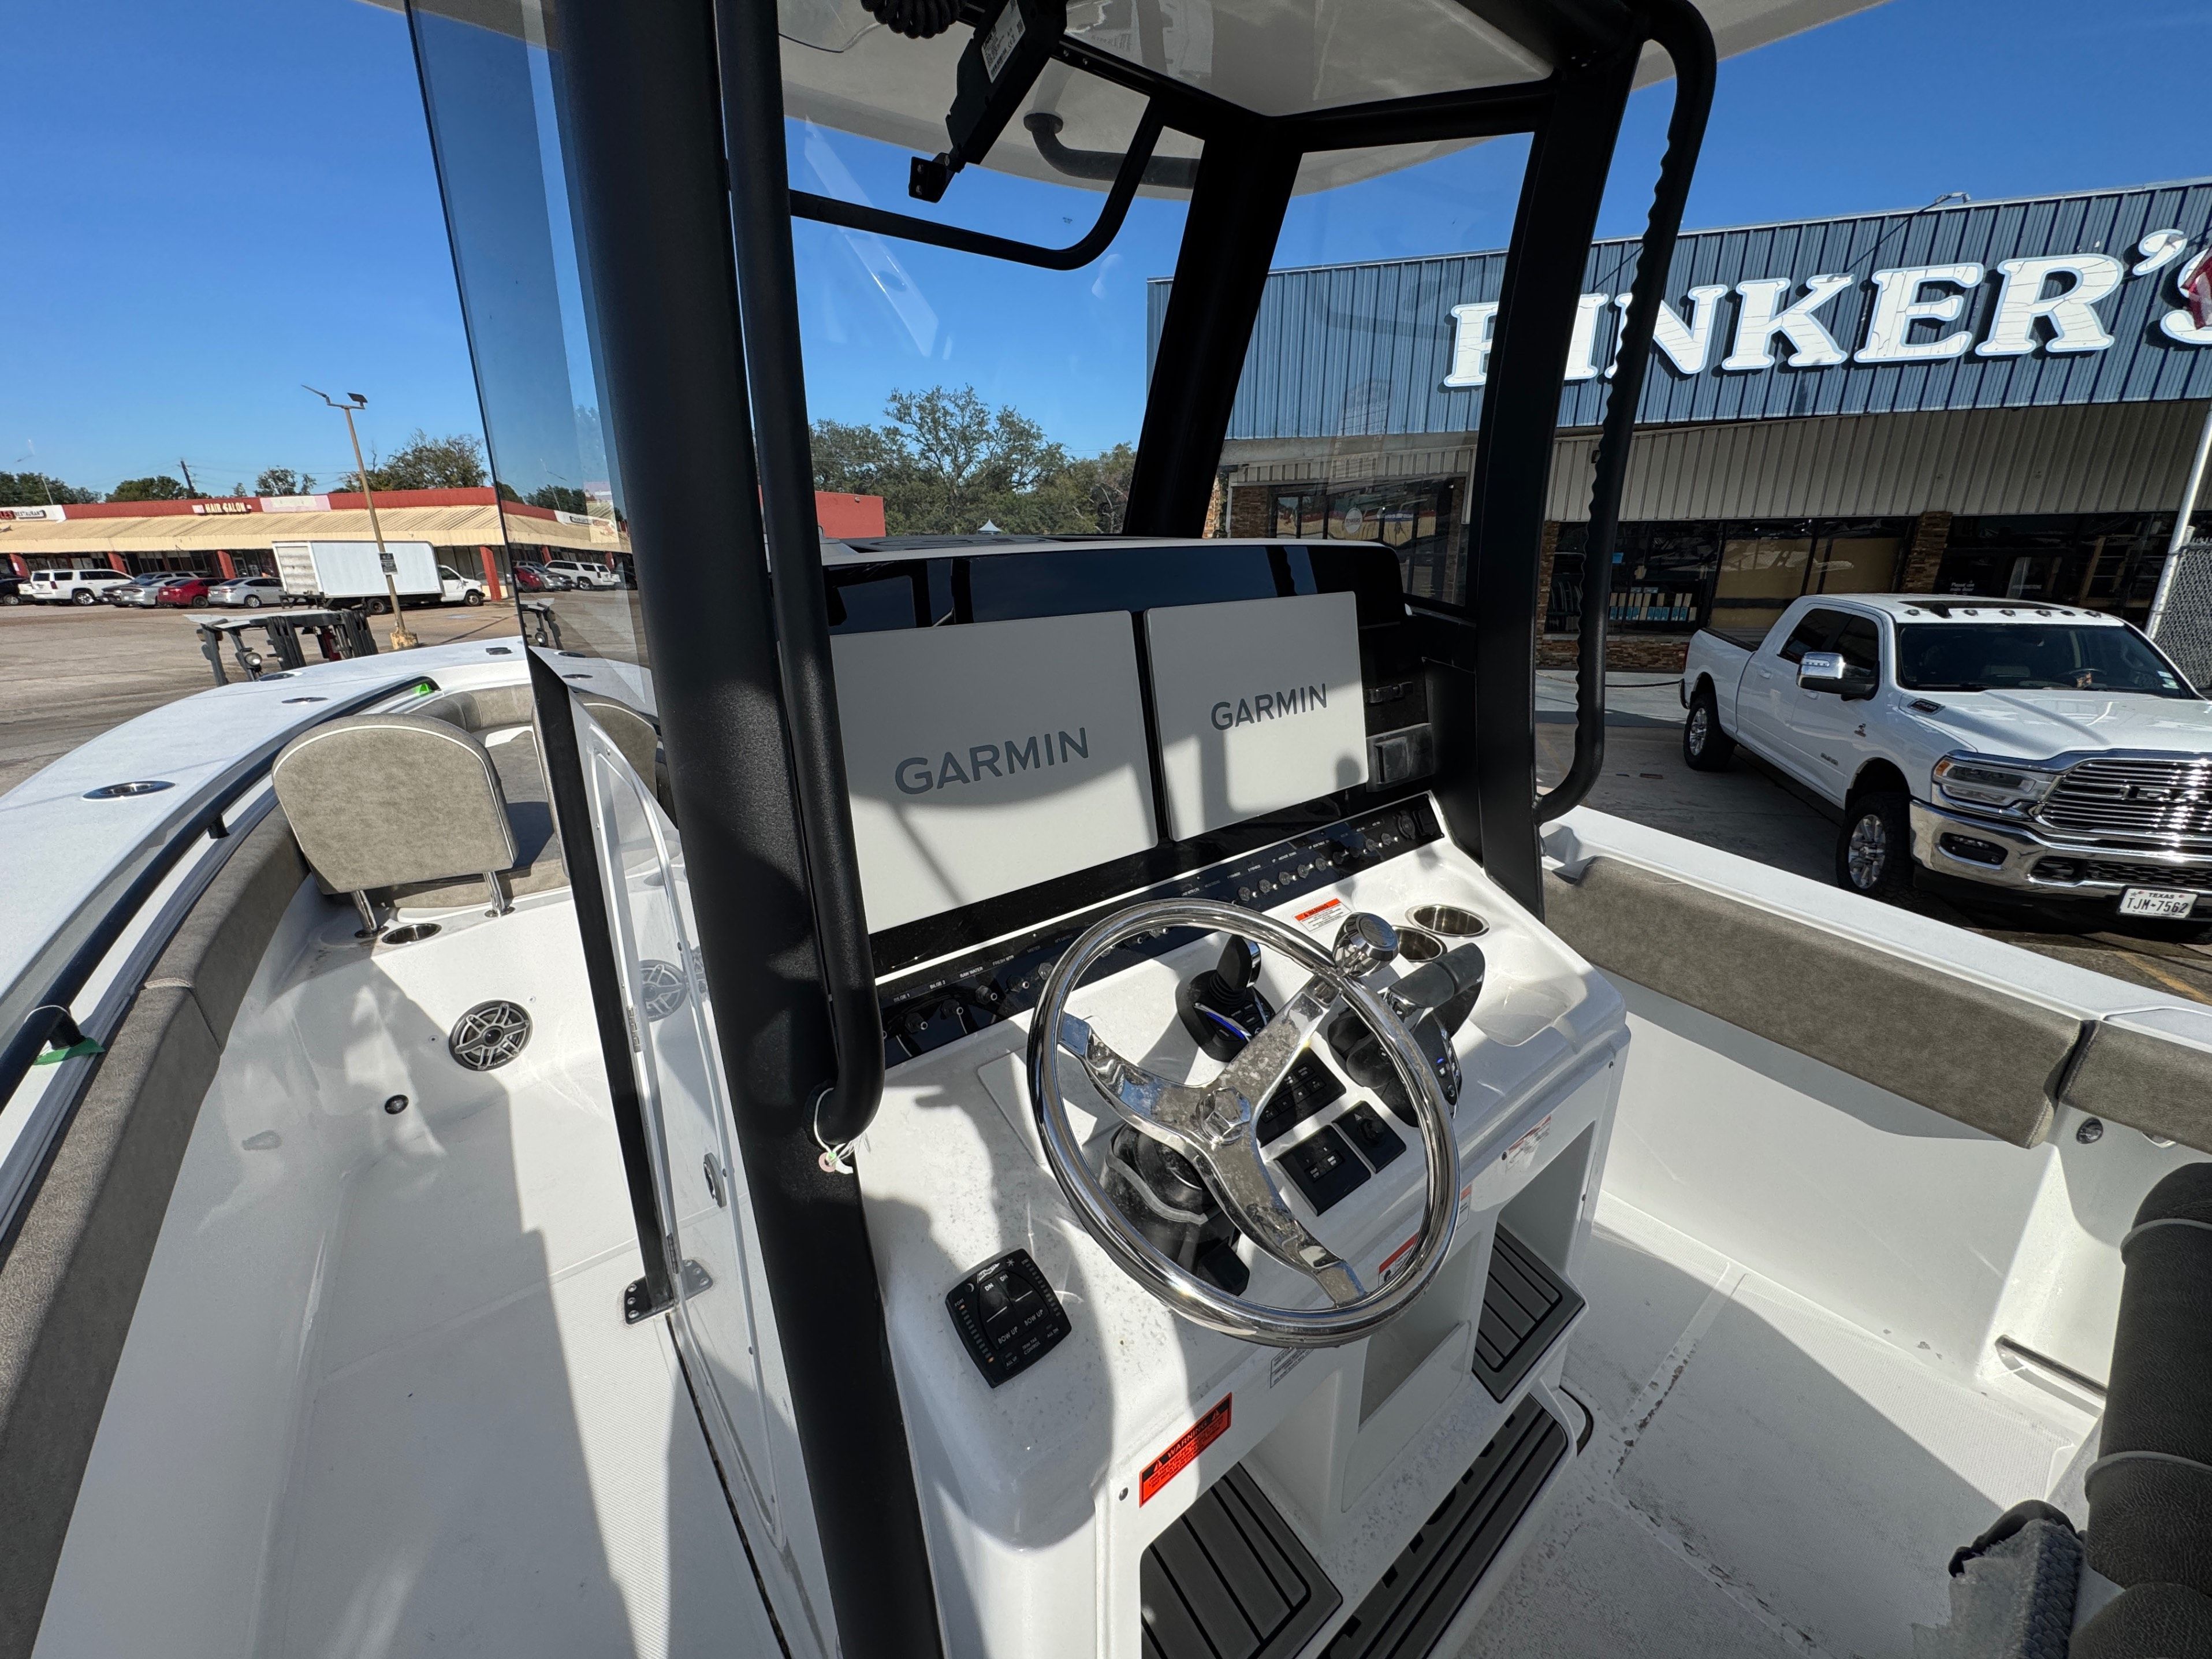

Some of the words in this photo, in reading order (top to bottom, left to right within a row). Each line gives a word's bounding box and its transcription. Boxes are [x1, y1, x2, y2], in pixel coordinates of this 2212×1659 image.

[205, 503, 222, 513] HAIR
[222, 502, 246, 512] SALON
[1211, 683, 1327, 731] GARMIN
[895, 727, 1088, 795] GARMIN
[959, 970, 970, 979] RAW
[969, 966, 983, 975] WATER
[1000, 1274, 1008, 1282] DN
[984, 1282, 995, 1292] DN
[1024, 1315, 1037, 1326] BOW
[1036, 1309, 1044, 1318] UP
[997, 1332, 1011, 1345] BOW
[1010, 1326, 1018, 1336] UP
[1023, 1341, 1041, 1355] CONTROL
[1167, 1421, 1208, 1459] WARNING
